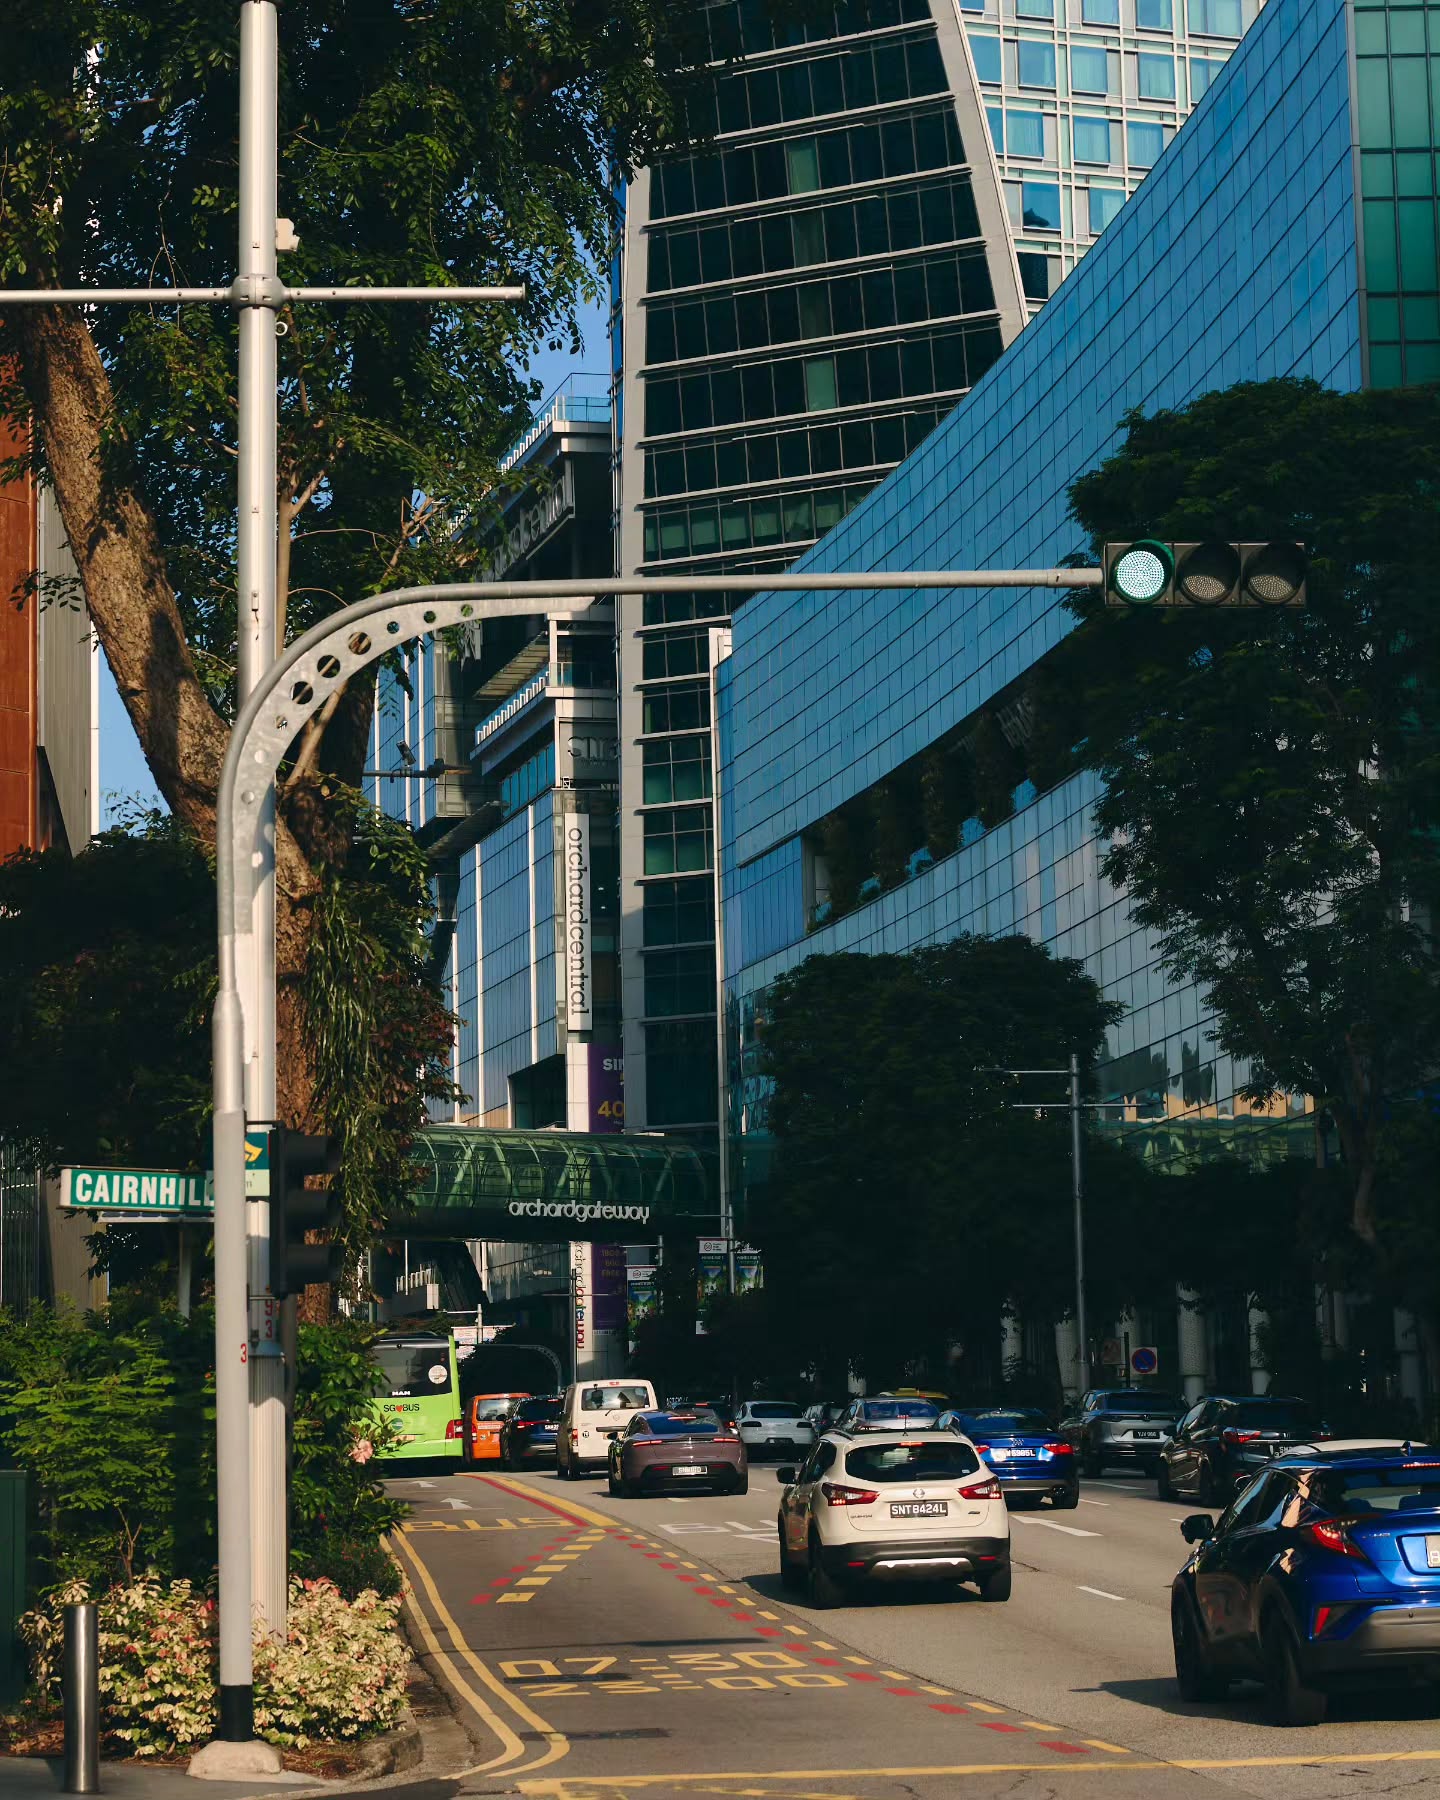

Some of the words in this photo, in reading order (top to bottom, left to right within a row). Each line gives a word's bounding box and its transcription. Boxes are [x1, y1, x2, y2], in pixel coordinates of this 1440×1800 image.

[568, 827, 589, 1016] orchardcentral
[509, 1199, 649, 1224] orchardgateway
[384, 1404, 396, 1413] SG
[403, 1403, 420, 1412] BUS
[401, 1516, 576, 1532] BUS
